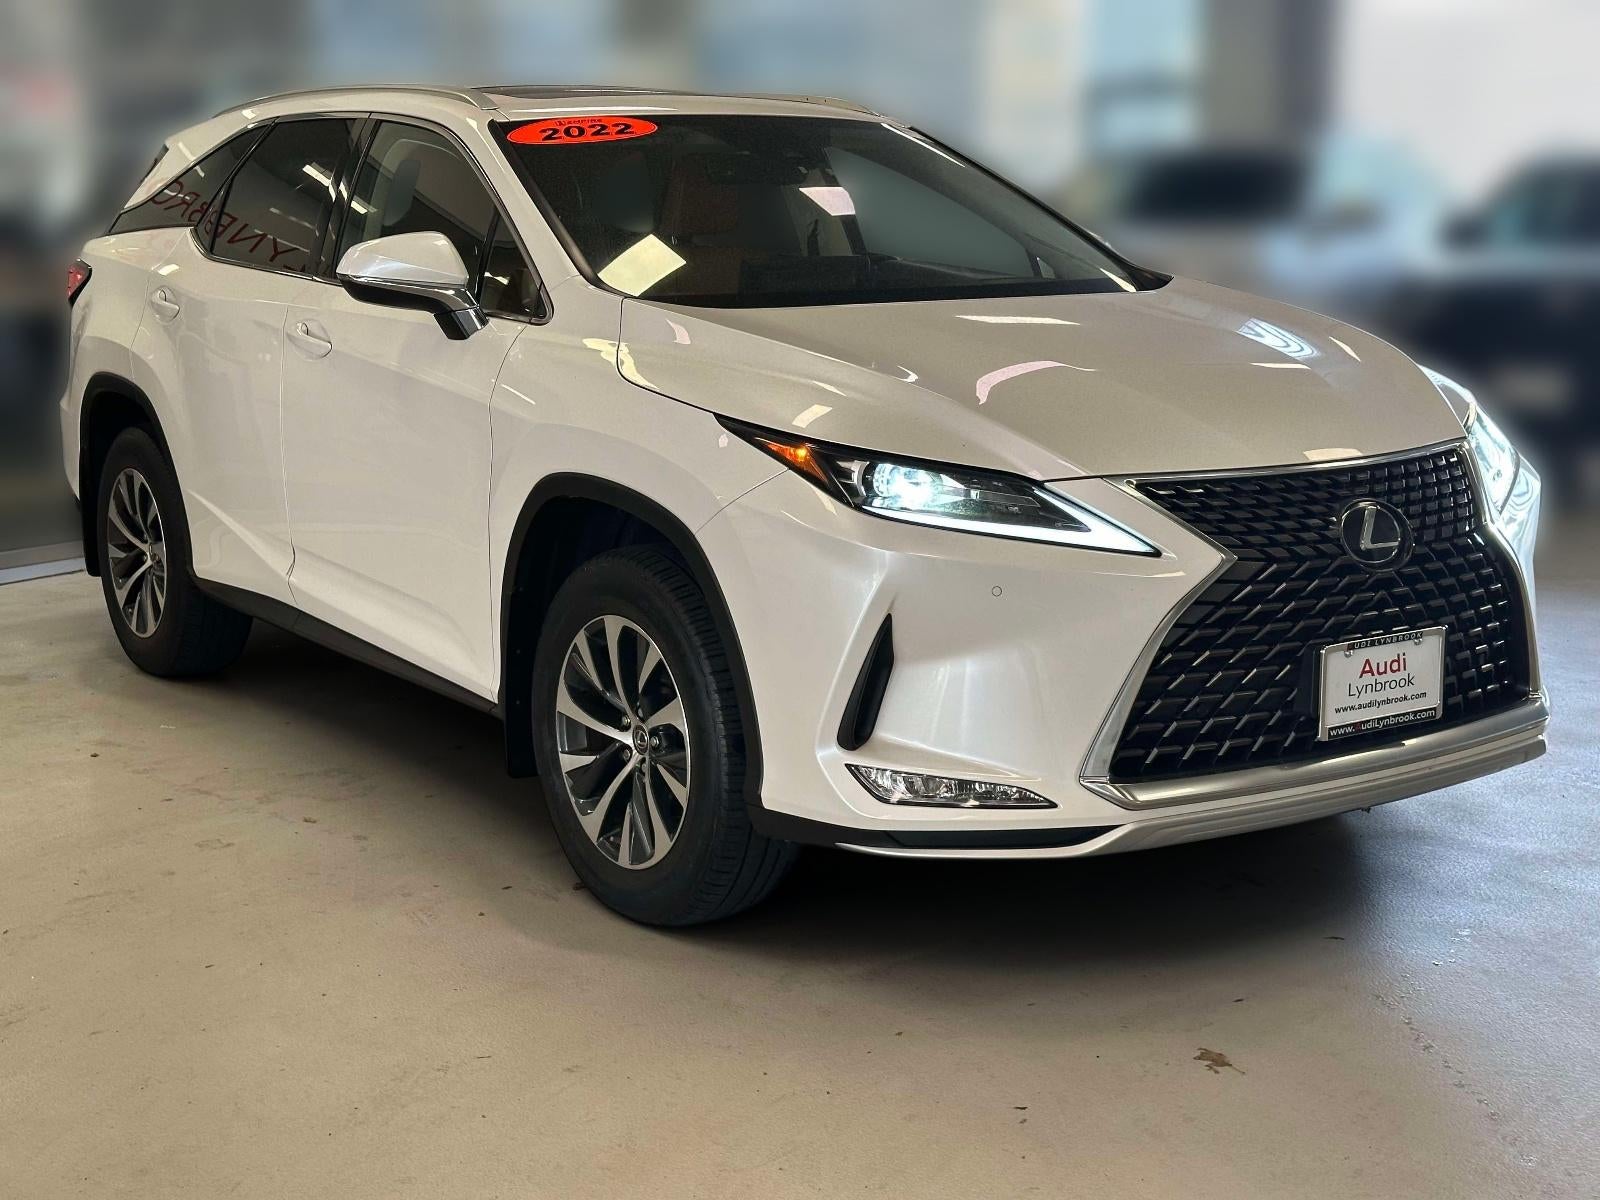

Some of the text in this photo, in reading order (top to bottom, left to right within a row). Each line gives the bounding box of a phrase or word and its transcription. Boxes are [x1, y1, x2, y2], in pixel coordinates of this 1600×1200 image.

[539, 122, 635, 141] 2022
[1375, 632, 1423, 646] LYNBROOK
[1359, 652, 1407, 678] Audi
[1348, 673, 1415, 698] Lynbrook
[1334, 691, 1427, 714] www.audilynbrook.com
